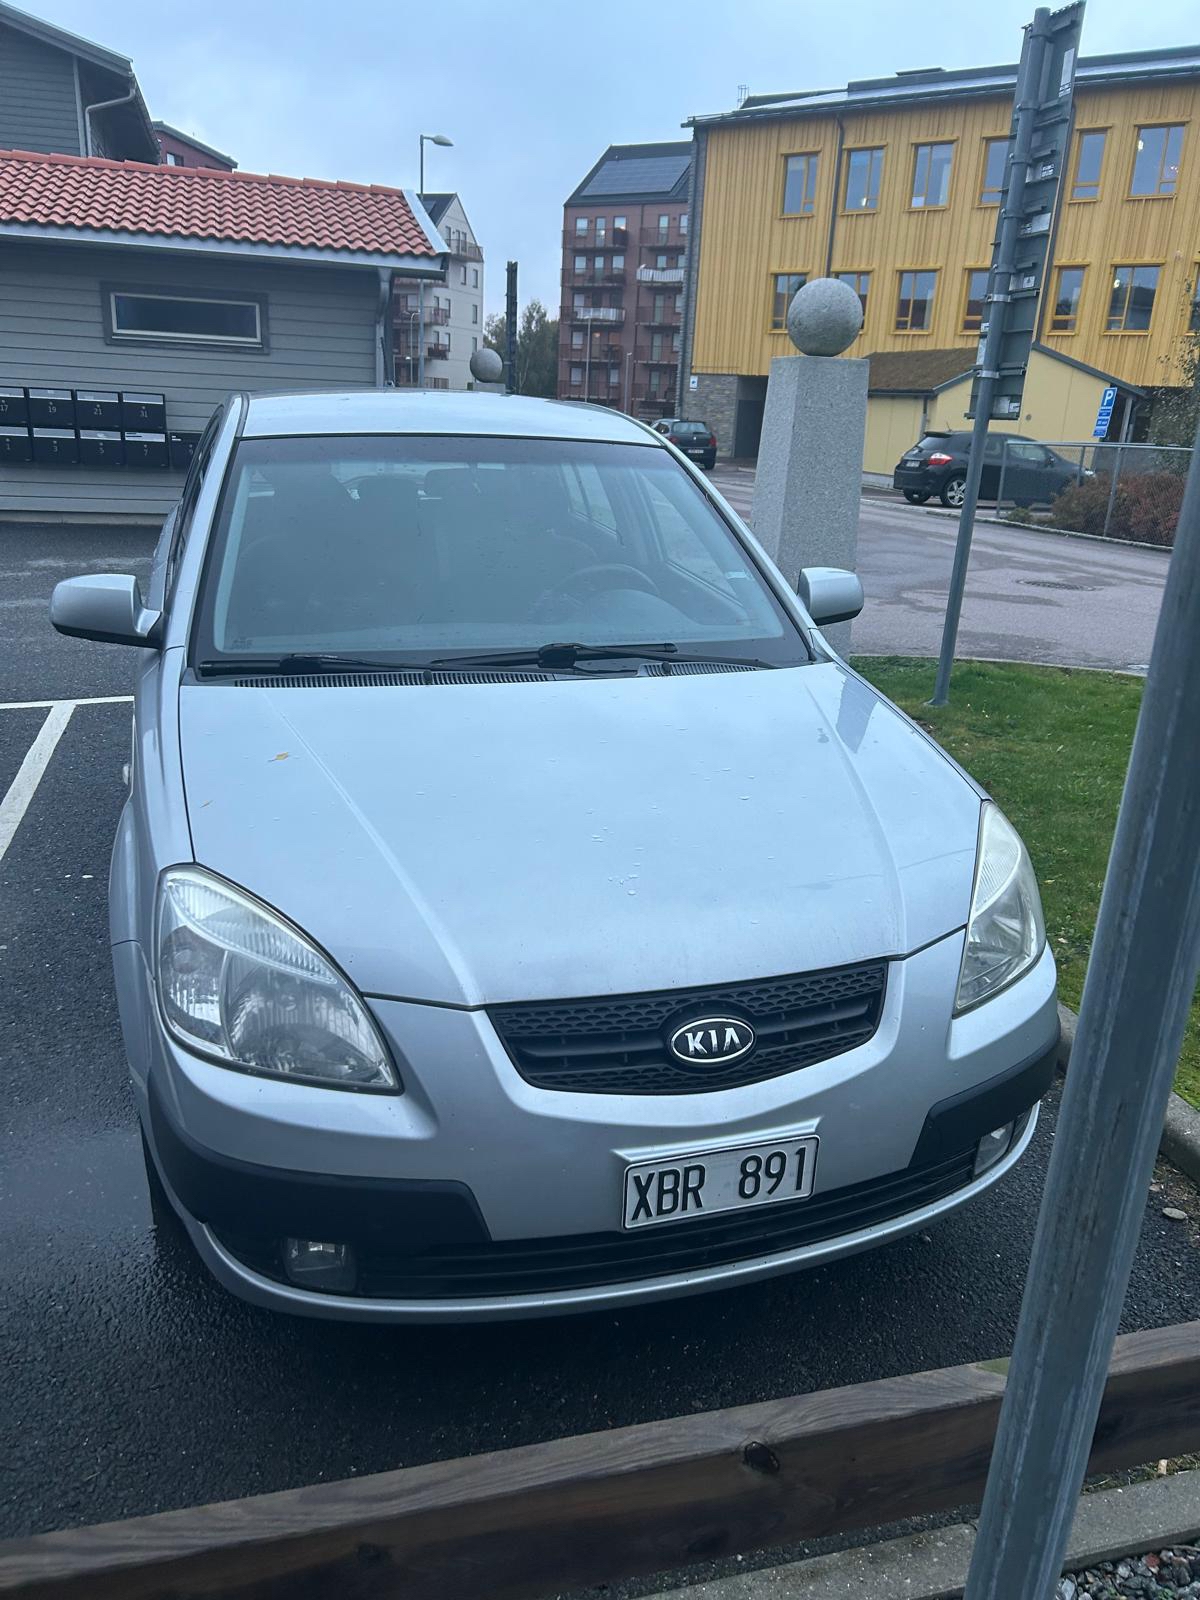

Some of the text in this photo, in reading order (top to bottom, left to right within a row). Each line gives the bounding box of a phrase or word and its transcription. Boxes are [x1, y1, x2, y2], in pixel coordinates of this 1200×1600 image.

[1103, 390, 1114, 406] P
[684, 1027, 742, 1056] KIA
[631, 1146, 807, 1221] XBR 891
